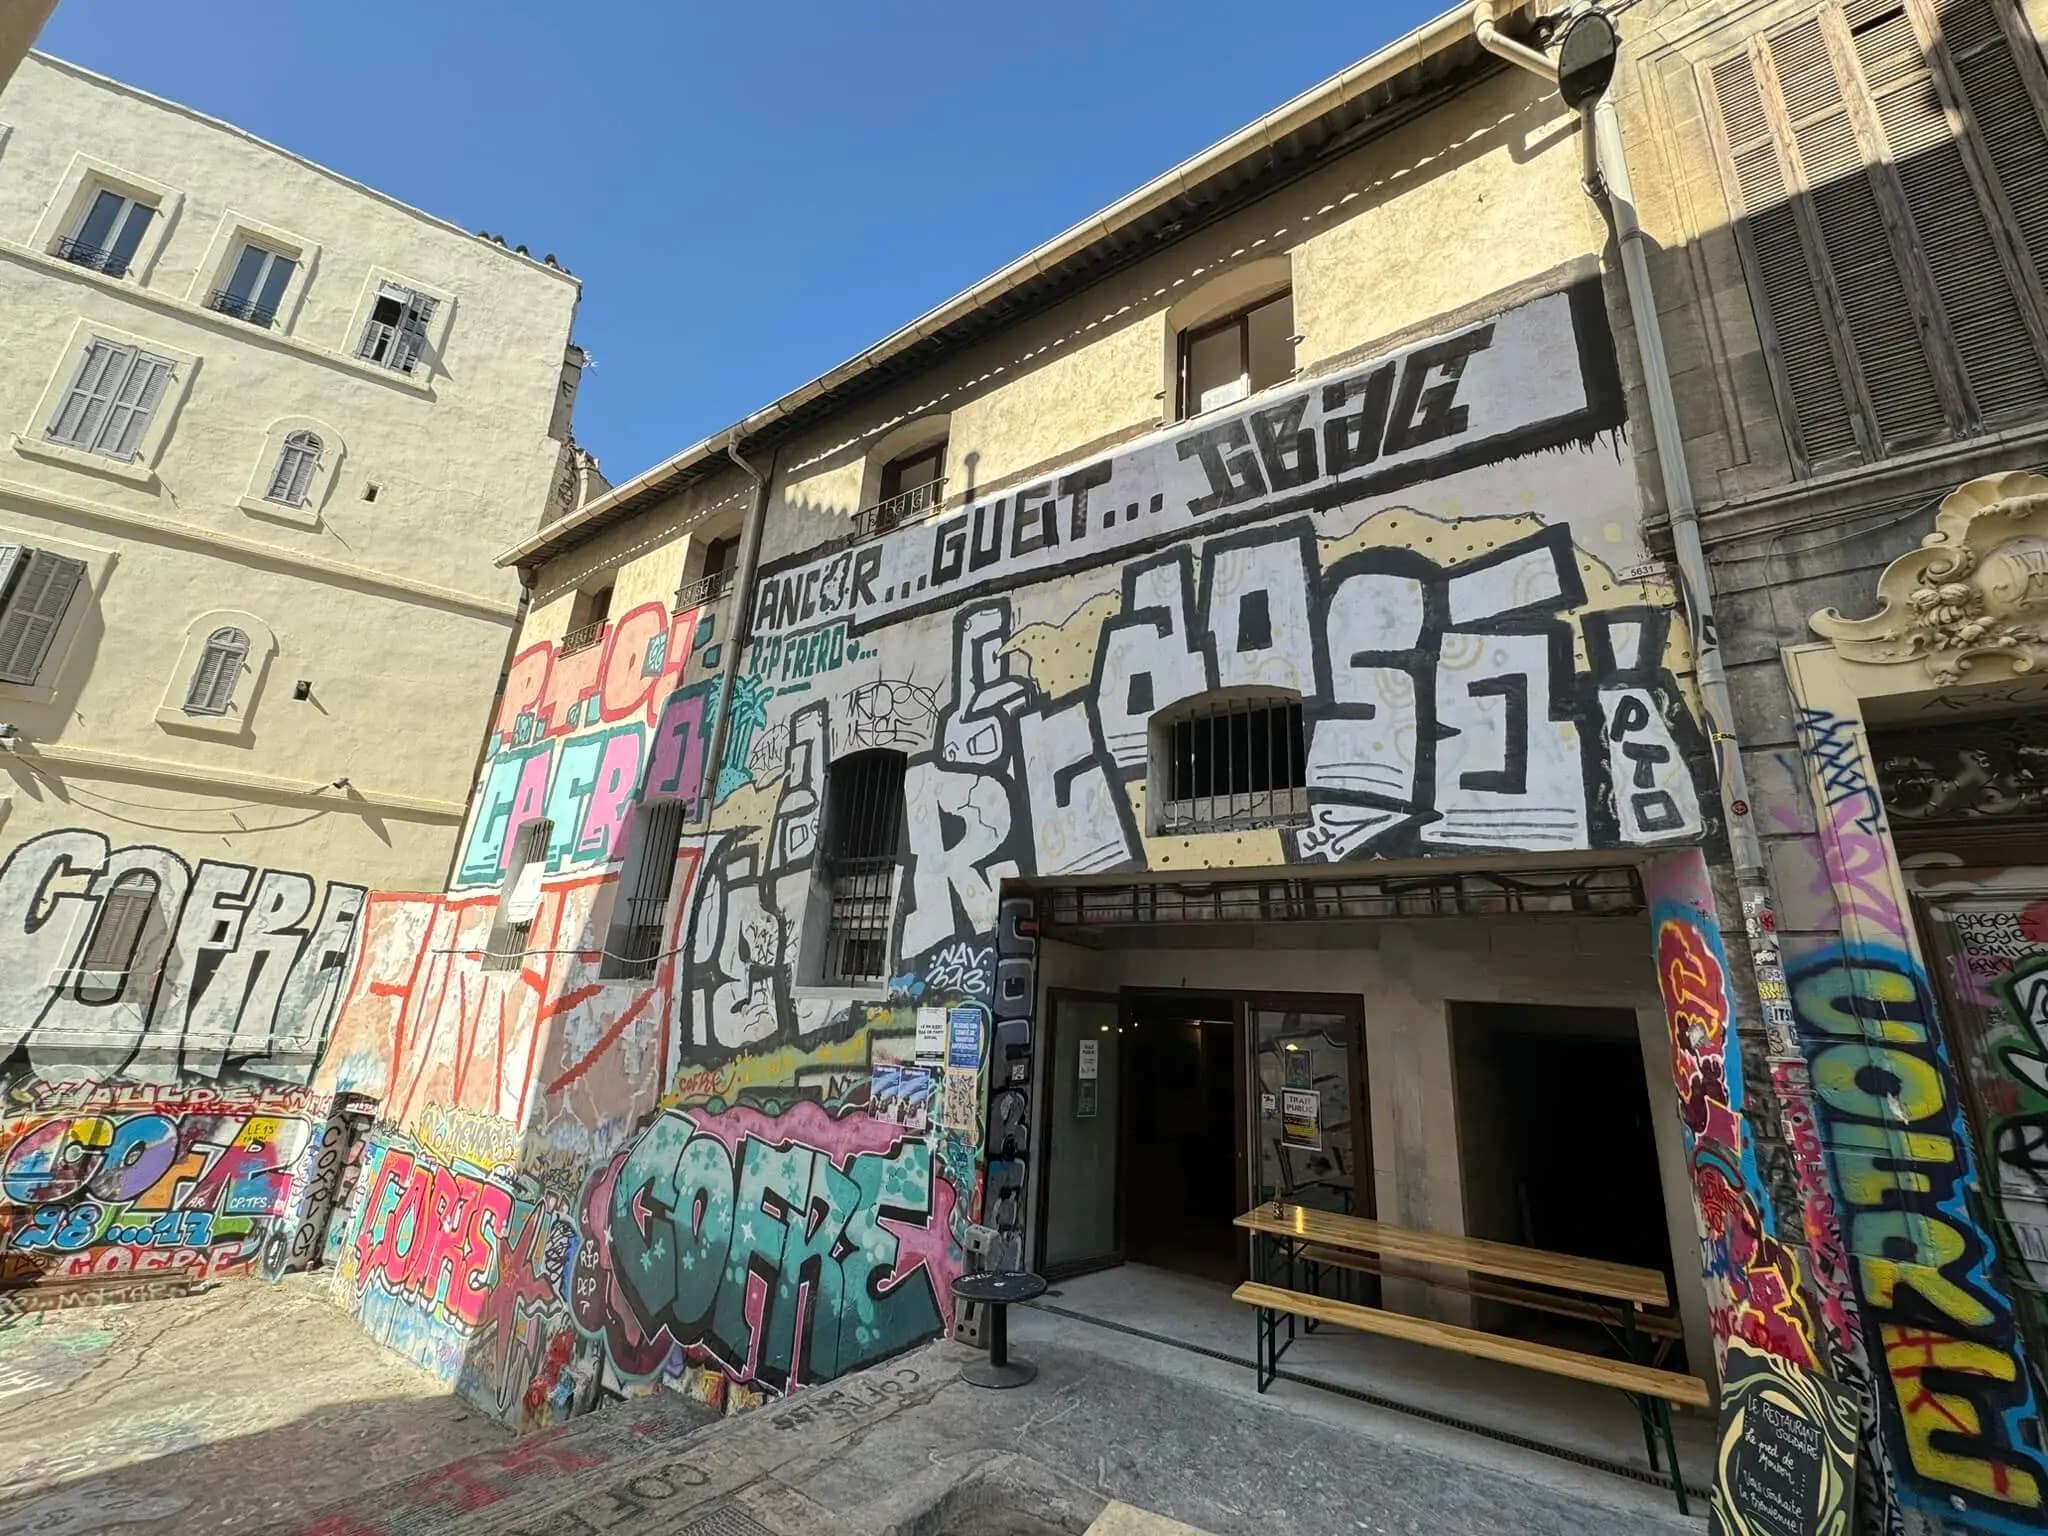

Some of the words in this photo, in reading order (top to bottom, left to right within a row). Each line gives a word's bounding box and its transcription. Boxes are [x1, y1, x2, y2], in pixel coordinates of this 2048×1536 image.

[1630, 564, 1655, 578] 5631
[782, 624, 846, 683] FRERO
[1748, 1393, 1760, 1416] LE
[1762, 1402, 1822, 1449] RESTAURANT
[1775, 1428, 1819, 1461] SOLIDAIRE
